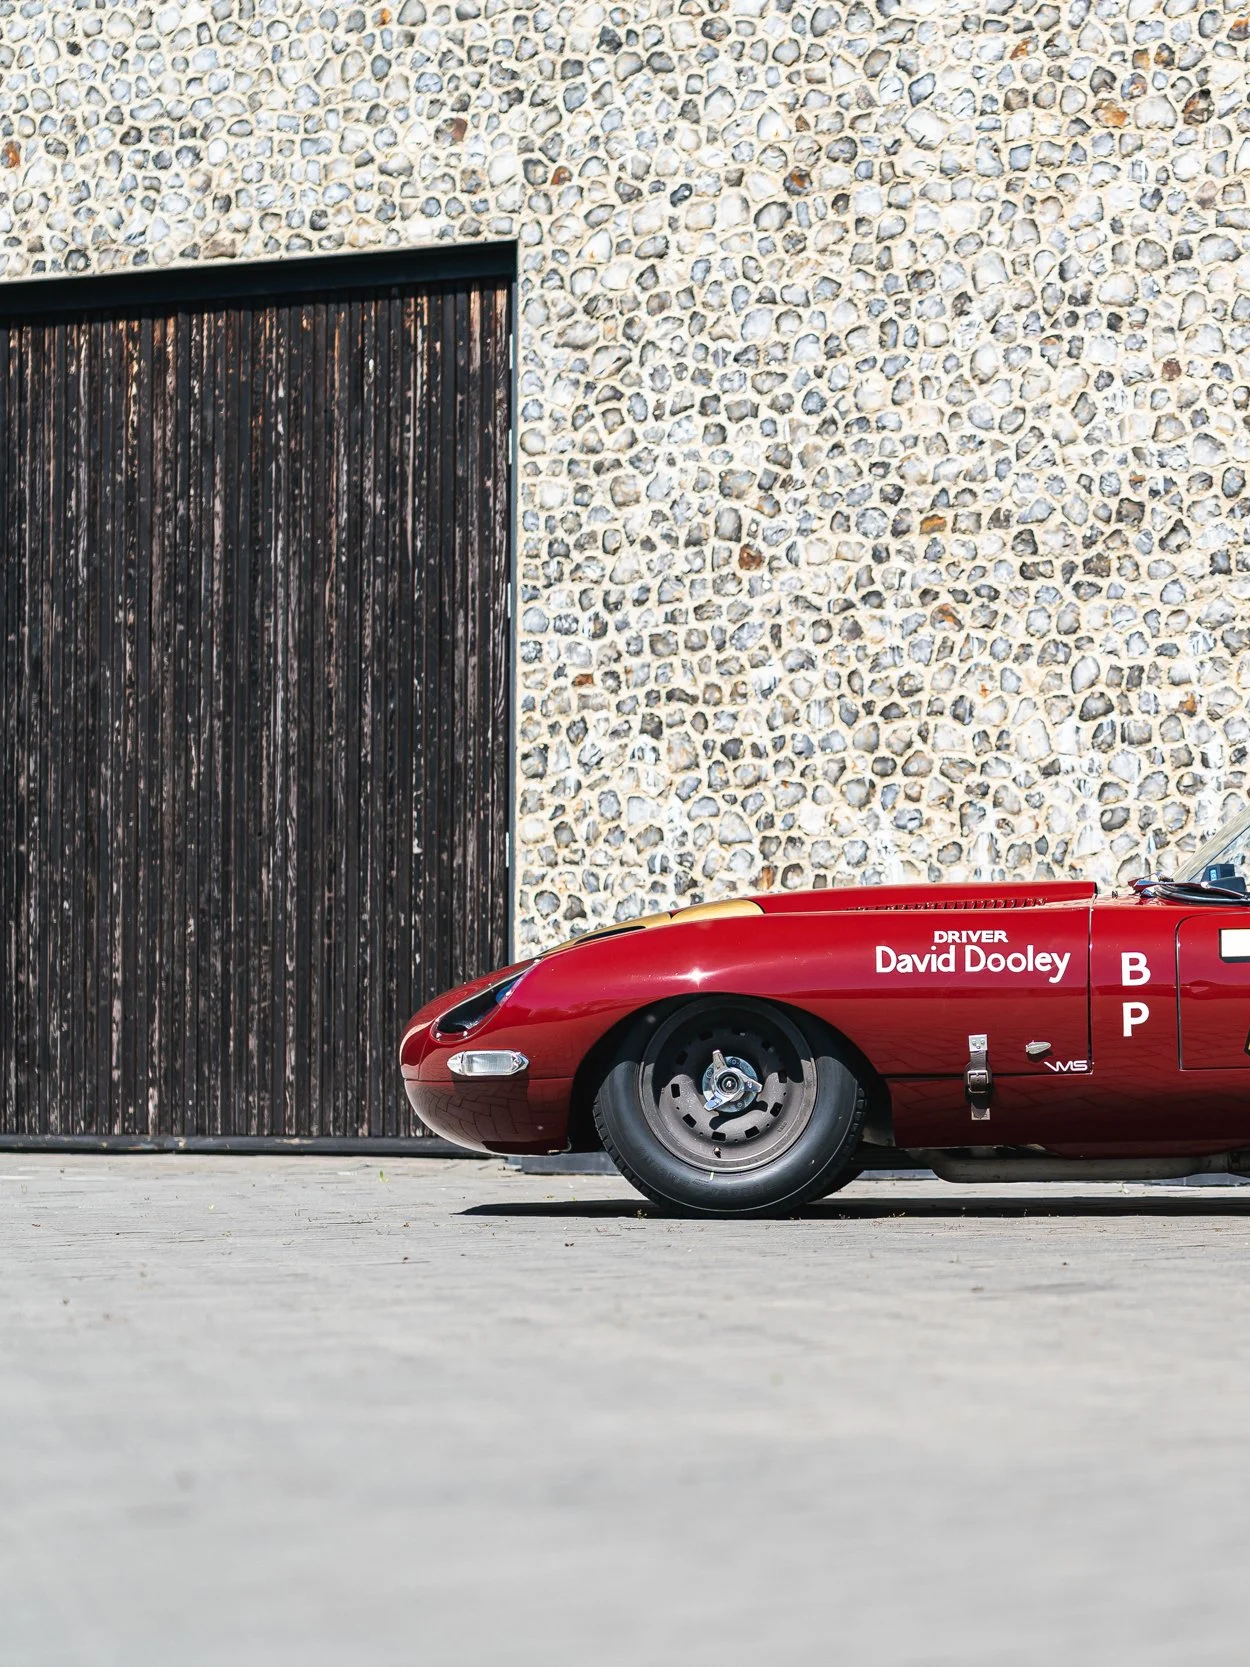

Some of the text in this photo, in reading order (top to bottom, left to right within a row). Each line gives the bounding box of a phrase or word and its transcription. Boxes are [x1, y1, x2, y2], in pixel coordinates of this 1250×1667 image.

[933, 930, 1009, 943] DRIVER
[875, 944, 1071, 984] David Dooley
[1120, 952, 1151, 987] B
[1122, 1001, 1150, 1038] P
